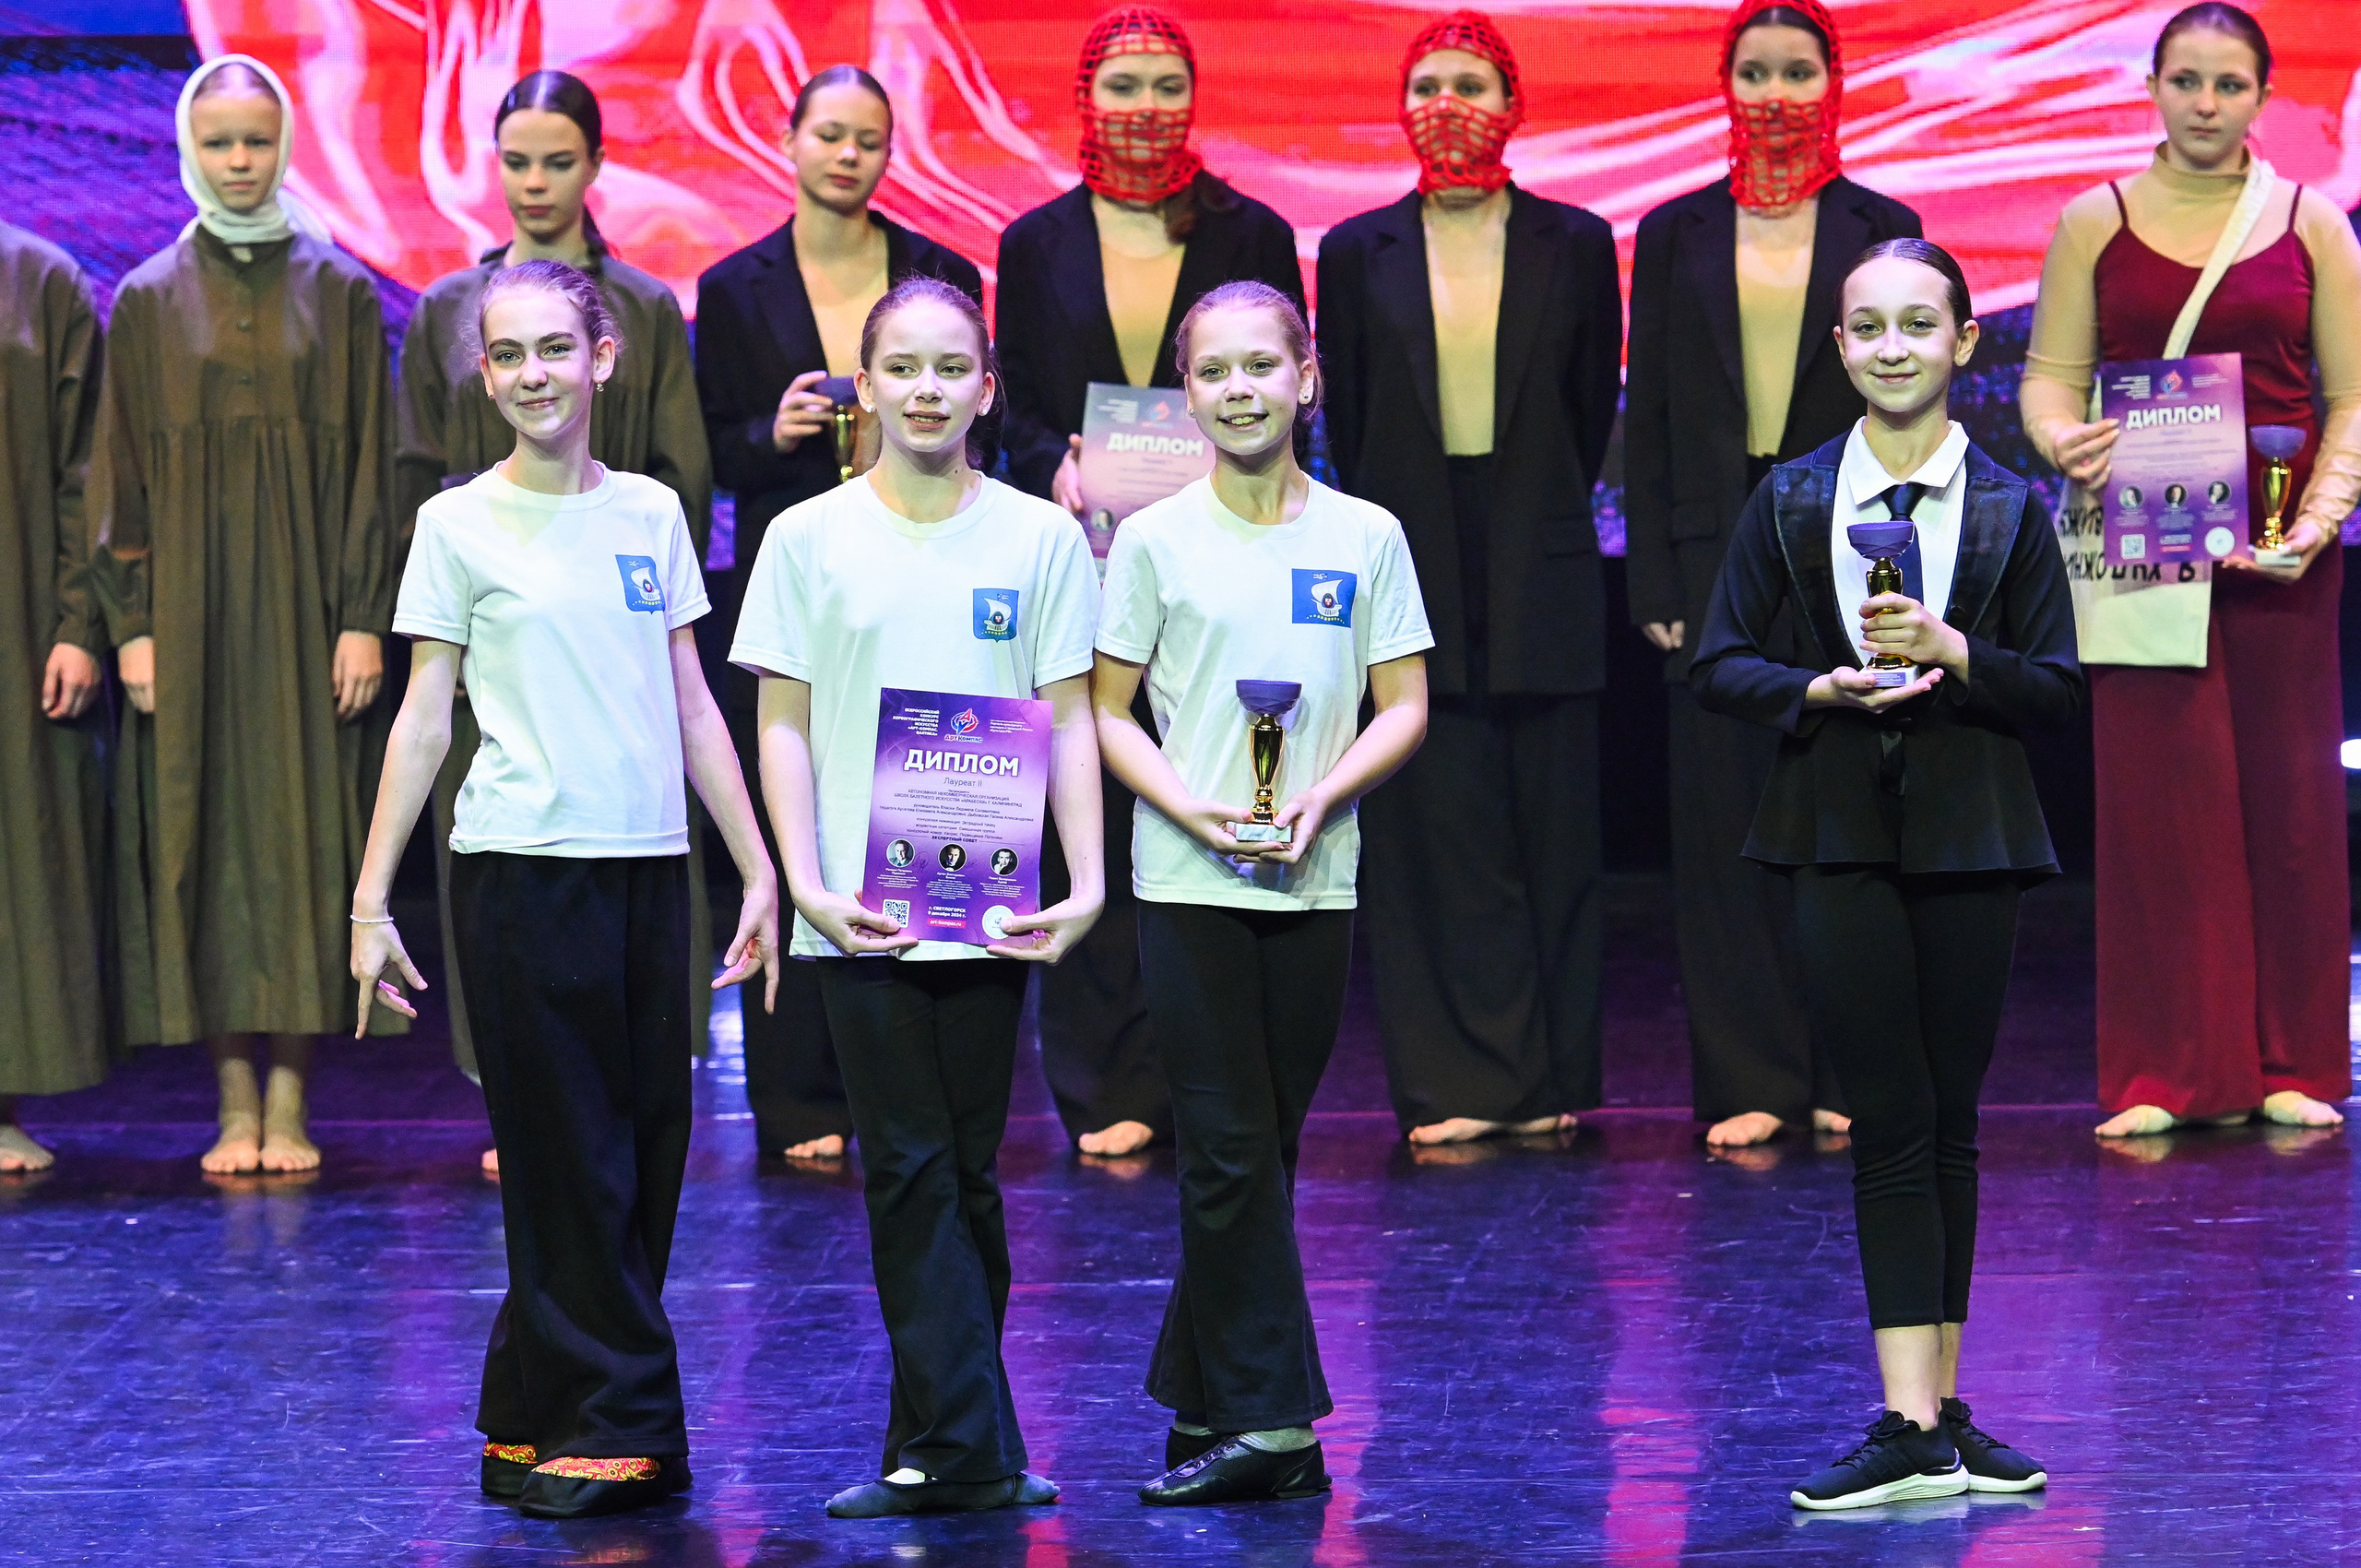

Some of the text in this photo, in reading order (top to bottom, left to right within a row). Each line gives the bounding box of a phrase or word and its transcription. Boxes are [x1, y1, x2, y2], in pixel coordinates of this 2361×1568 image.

[2125, 404, 2222, 431] ДИПЛОМ
[1106, 433, 1204, 457] ДИПЛОМ
[904, 749, 1019, 777] ДИПЛОМ
[943, 777, 977, 788] Лауреат
